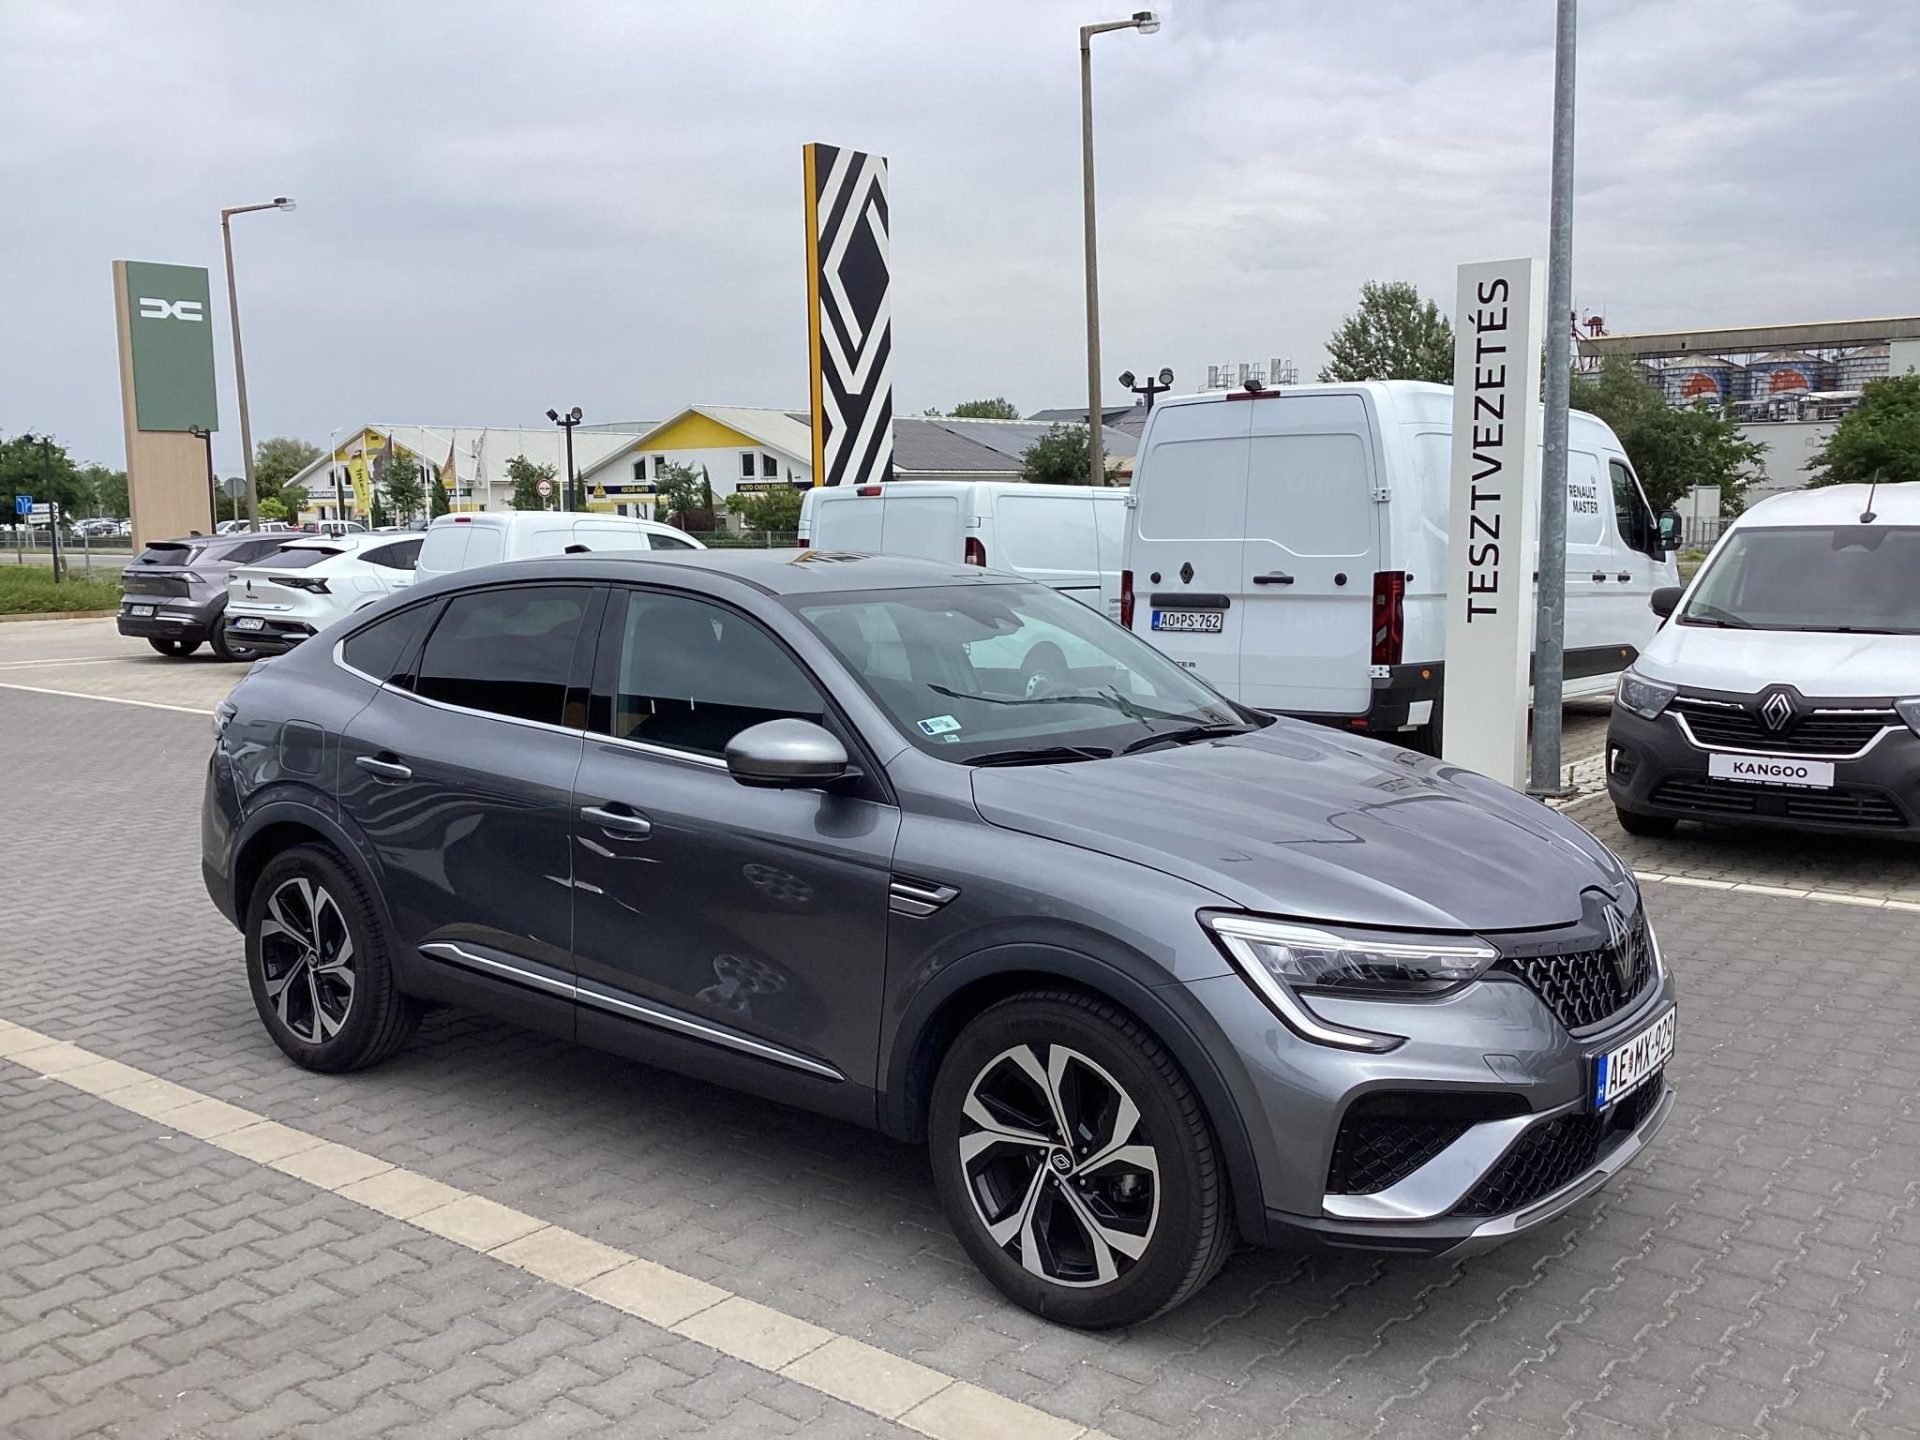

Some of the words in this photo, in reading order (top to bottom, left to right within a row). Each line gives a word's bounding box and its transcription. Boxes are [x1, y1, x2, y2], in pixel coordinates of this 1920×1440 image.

[1467, 278, 1509, 623] TESZTVEZETÉS
[1568, 485, 1596, 499] RENAULT
[1572, 500, 1598, 514] MASTER
[1161, 613, 1175, 627] AO
[1181, 614, 1219, 628] PS-762
[1734, 762, 1807, 778] KANGOO
[1598, 1083, 1606, 1099] H
[1609, 1048, 1629, 1096] AE
[1634, 1013, 1673, 1077] MX-929
